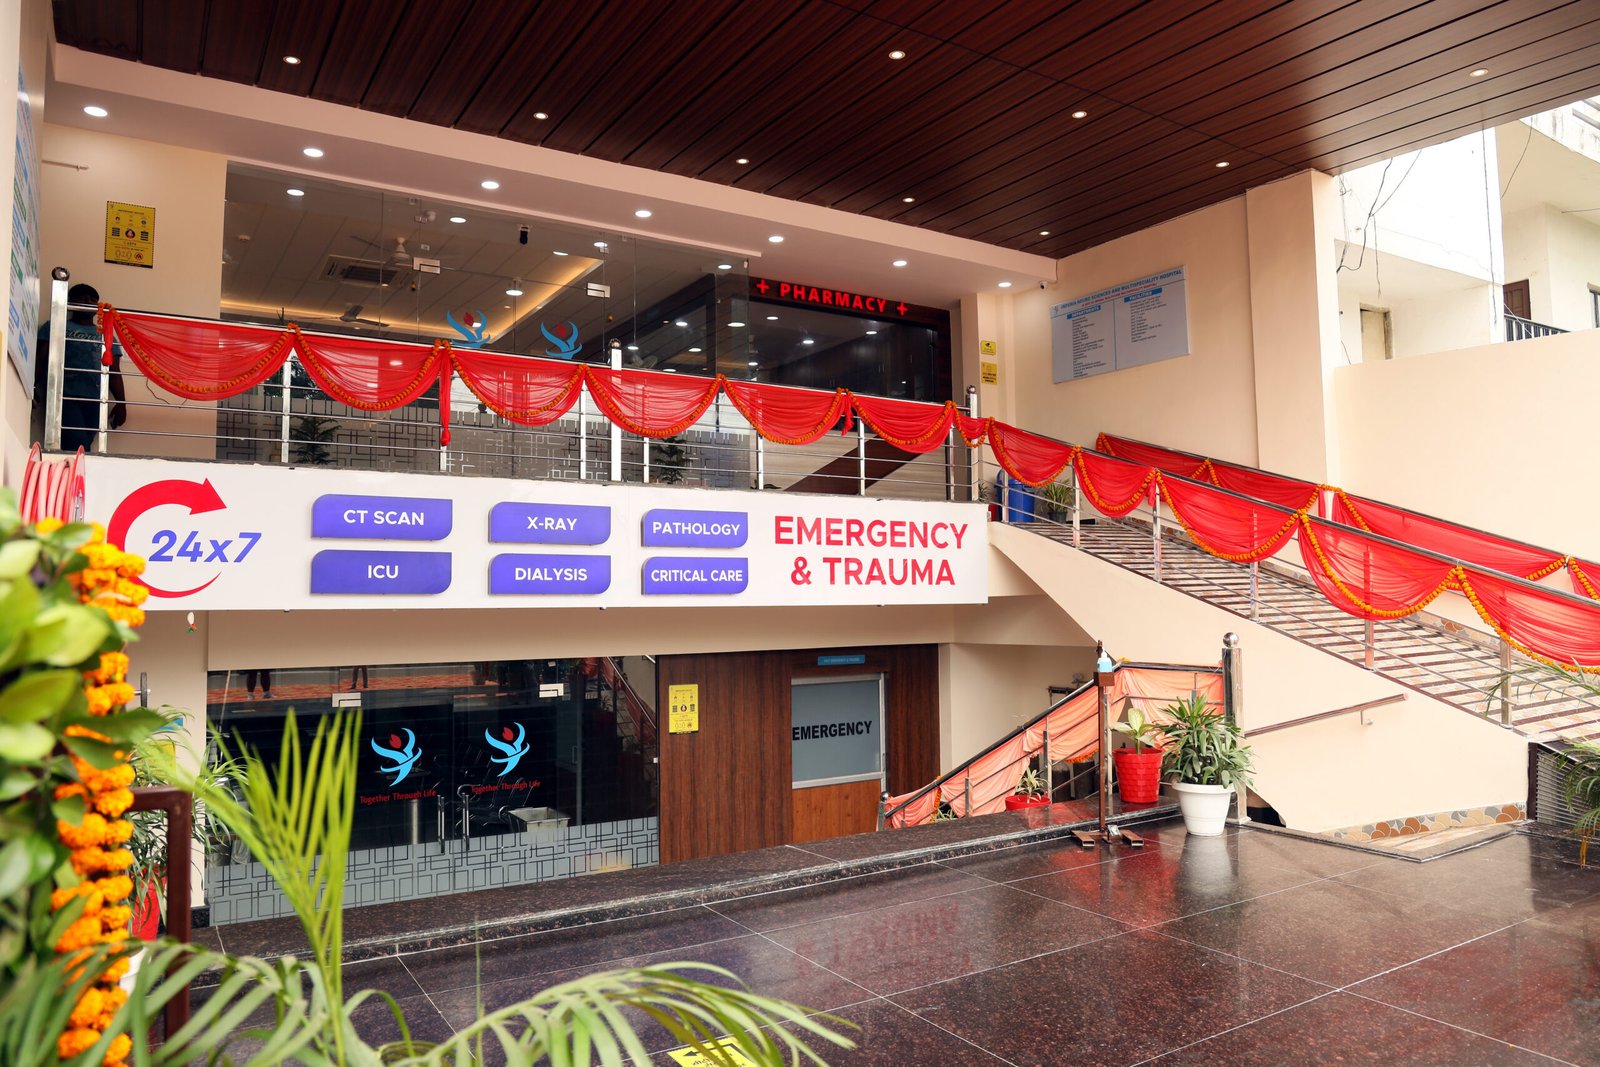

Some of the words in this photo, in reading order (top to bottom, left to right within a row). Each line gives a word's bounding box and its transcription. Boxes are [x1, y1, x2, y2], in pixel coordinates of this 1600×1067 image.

[1091, 290, 1111, 301] SCIENCES
[1111, 287, 1121, 295] AND
[1159, 270, 1182, 281] HOSPITAL
[780, 282, 886, 313] PHARMACY
[343, 510, 368, 524] CT
[373, 510, 425, 526] SCAN
[527, 516, 577, 531] X-RAY
[652, 521, 740, 536] PATHOLOGY
[775, 515, 968, 549] EMERGENCY
[148, 529, 262, 563] 24x7
[367, 564, 399, 579] ICU
[515, 567, 588, 581] DIALYSIS
[651, 569, 707, 582] CRITICAL
[710, 569, 743, 582] CARE
[790, 556, 812, 585] &
[822, 556, 956, 585] TRAUMA
[792, 720, 872, 741] EMERGENCY
[471, 784, 498, 795] Together
[501, 781, 528, 791] Through
[528, 780, 541, 788] Life
[360, 794, 391, 806] Together
[393, 791, 422, 802] Through
[423, 788, 437, 797] Life
